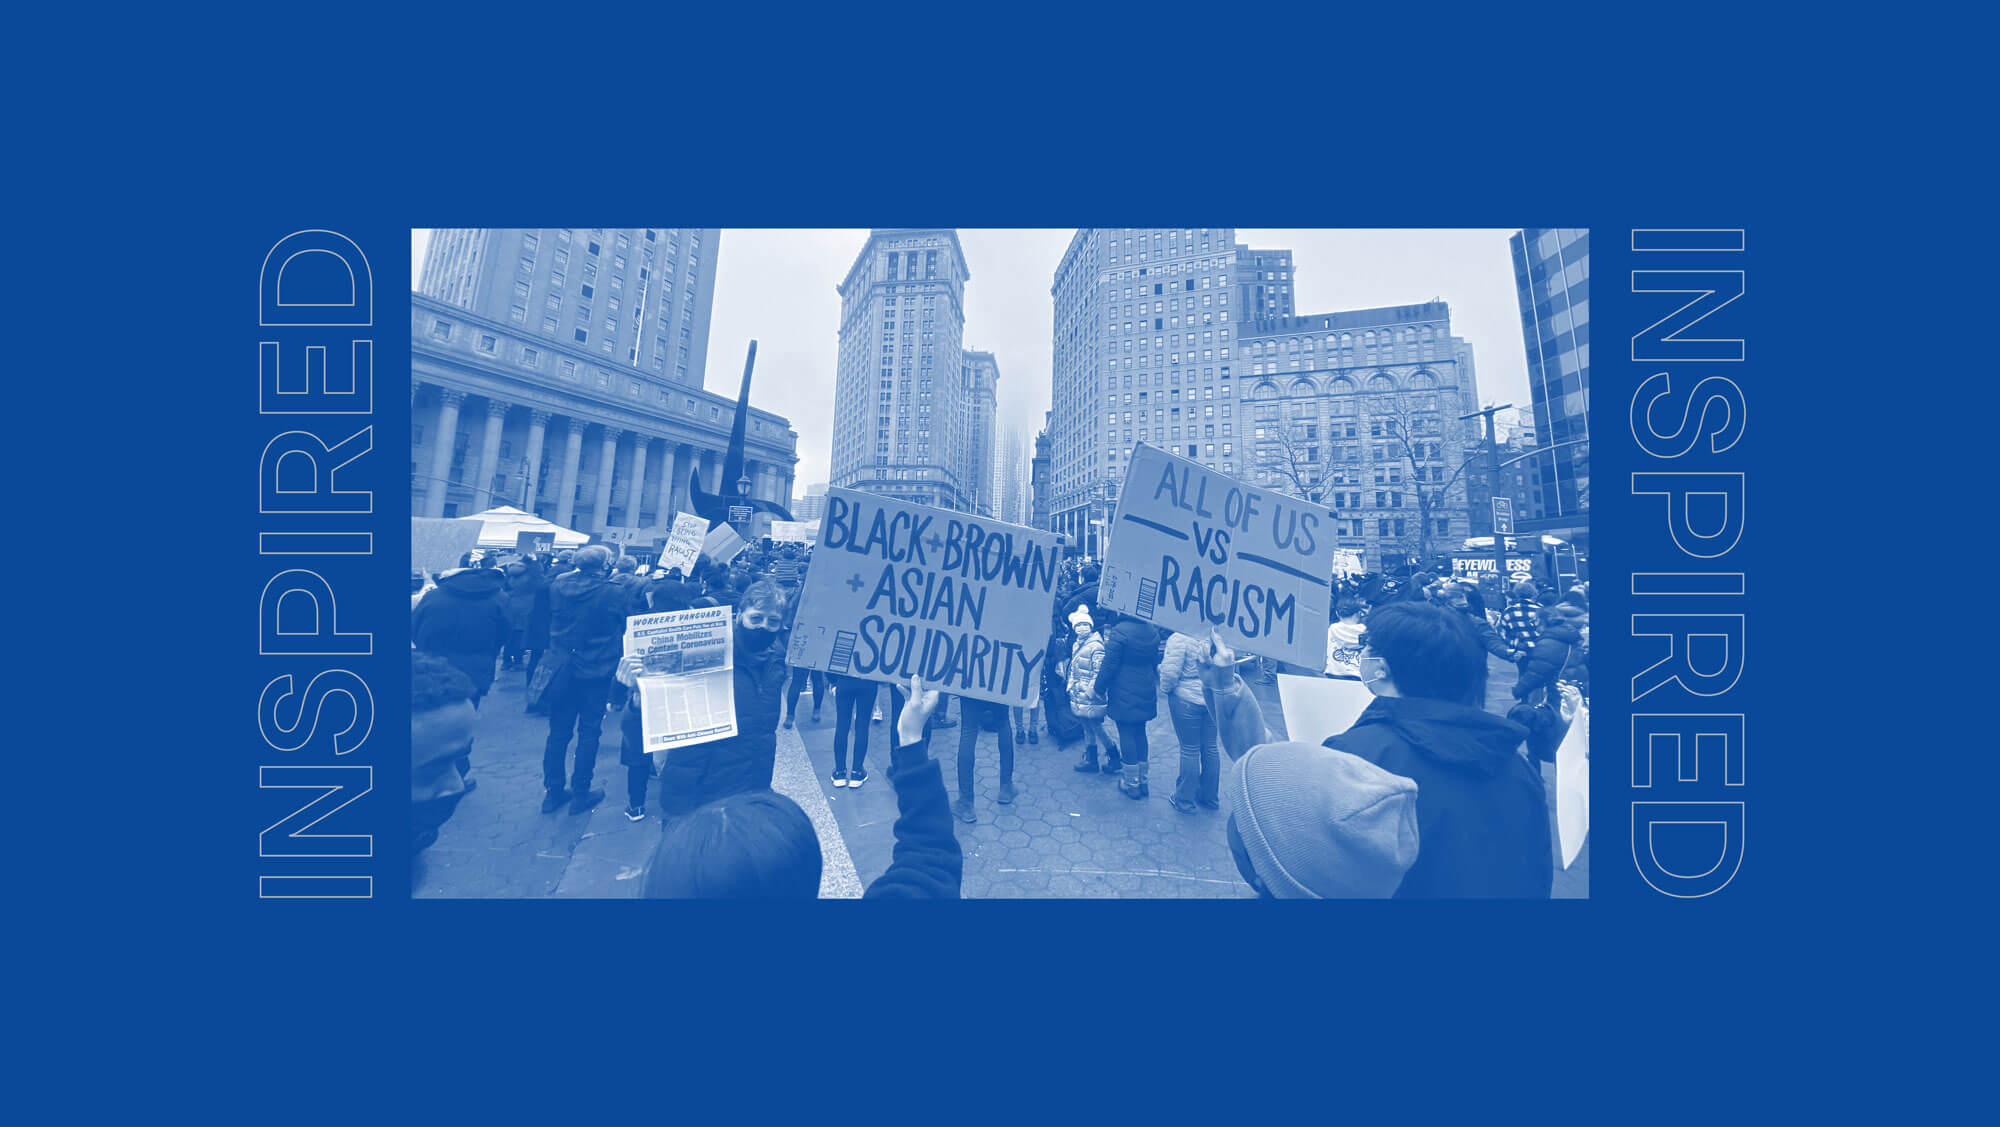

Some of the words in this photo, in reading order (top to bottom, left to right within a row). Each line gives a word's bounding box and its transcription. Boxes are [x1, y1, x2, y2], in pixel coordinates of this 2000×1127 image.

[1153, 461, 1213, 519] ALL
[1224, 487, 1262, 533] OF
[1272, 503, 1320, 556] US
[1192, 520, 1231, 565] VS
[633, 615, 677, 627] WORKERS
[679, 609, 722, 621] VANGUARD
[866, 562, 987, 631] ASIAN
[1157, 554, 1297, 645] RACISM
[651, 636, 674, 645] China
[676, 631, 713, 641] Mobilizes
[680, 637, 725, 650] Coronavirus
[852, 614, 1045, 701] SOLIDARITY
